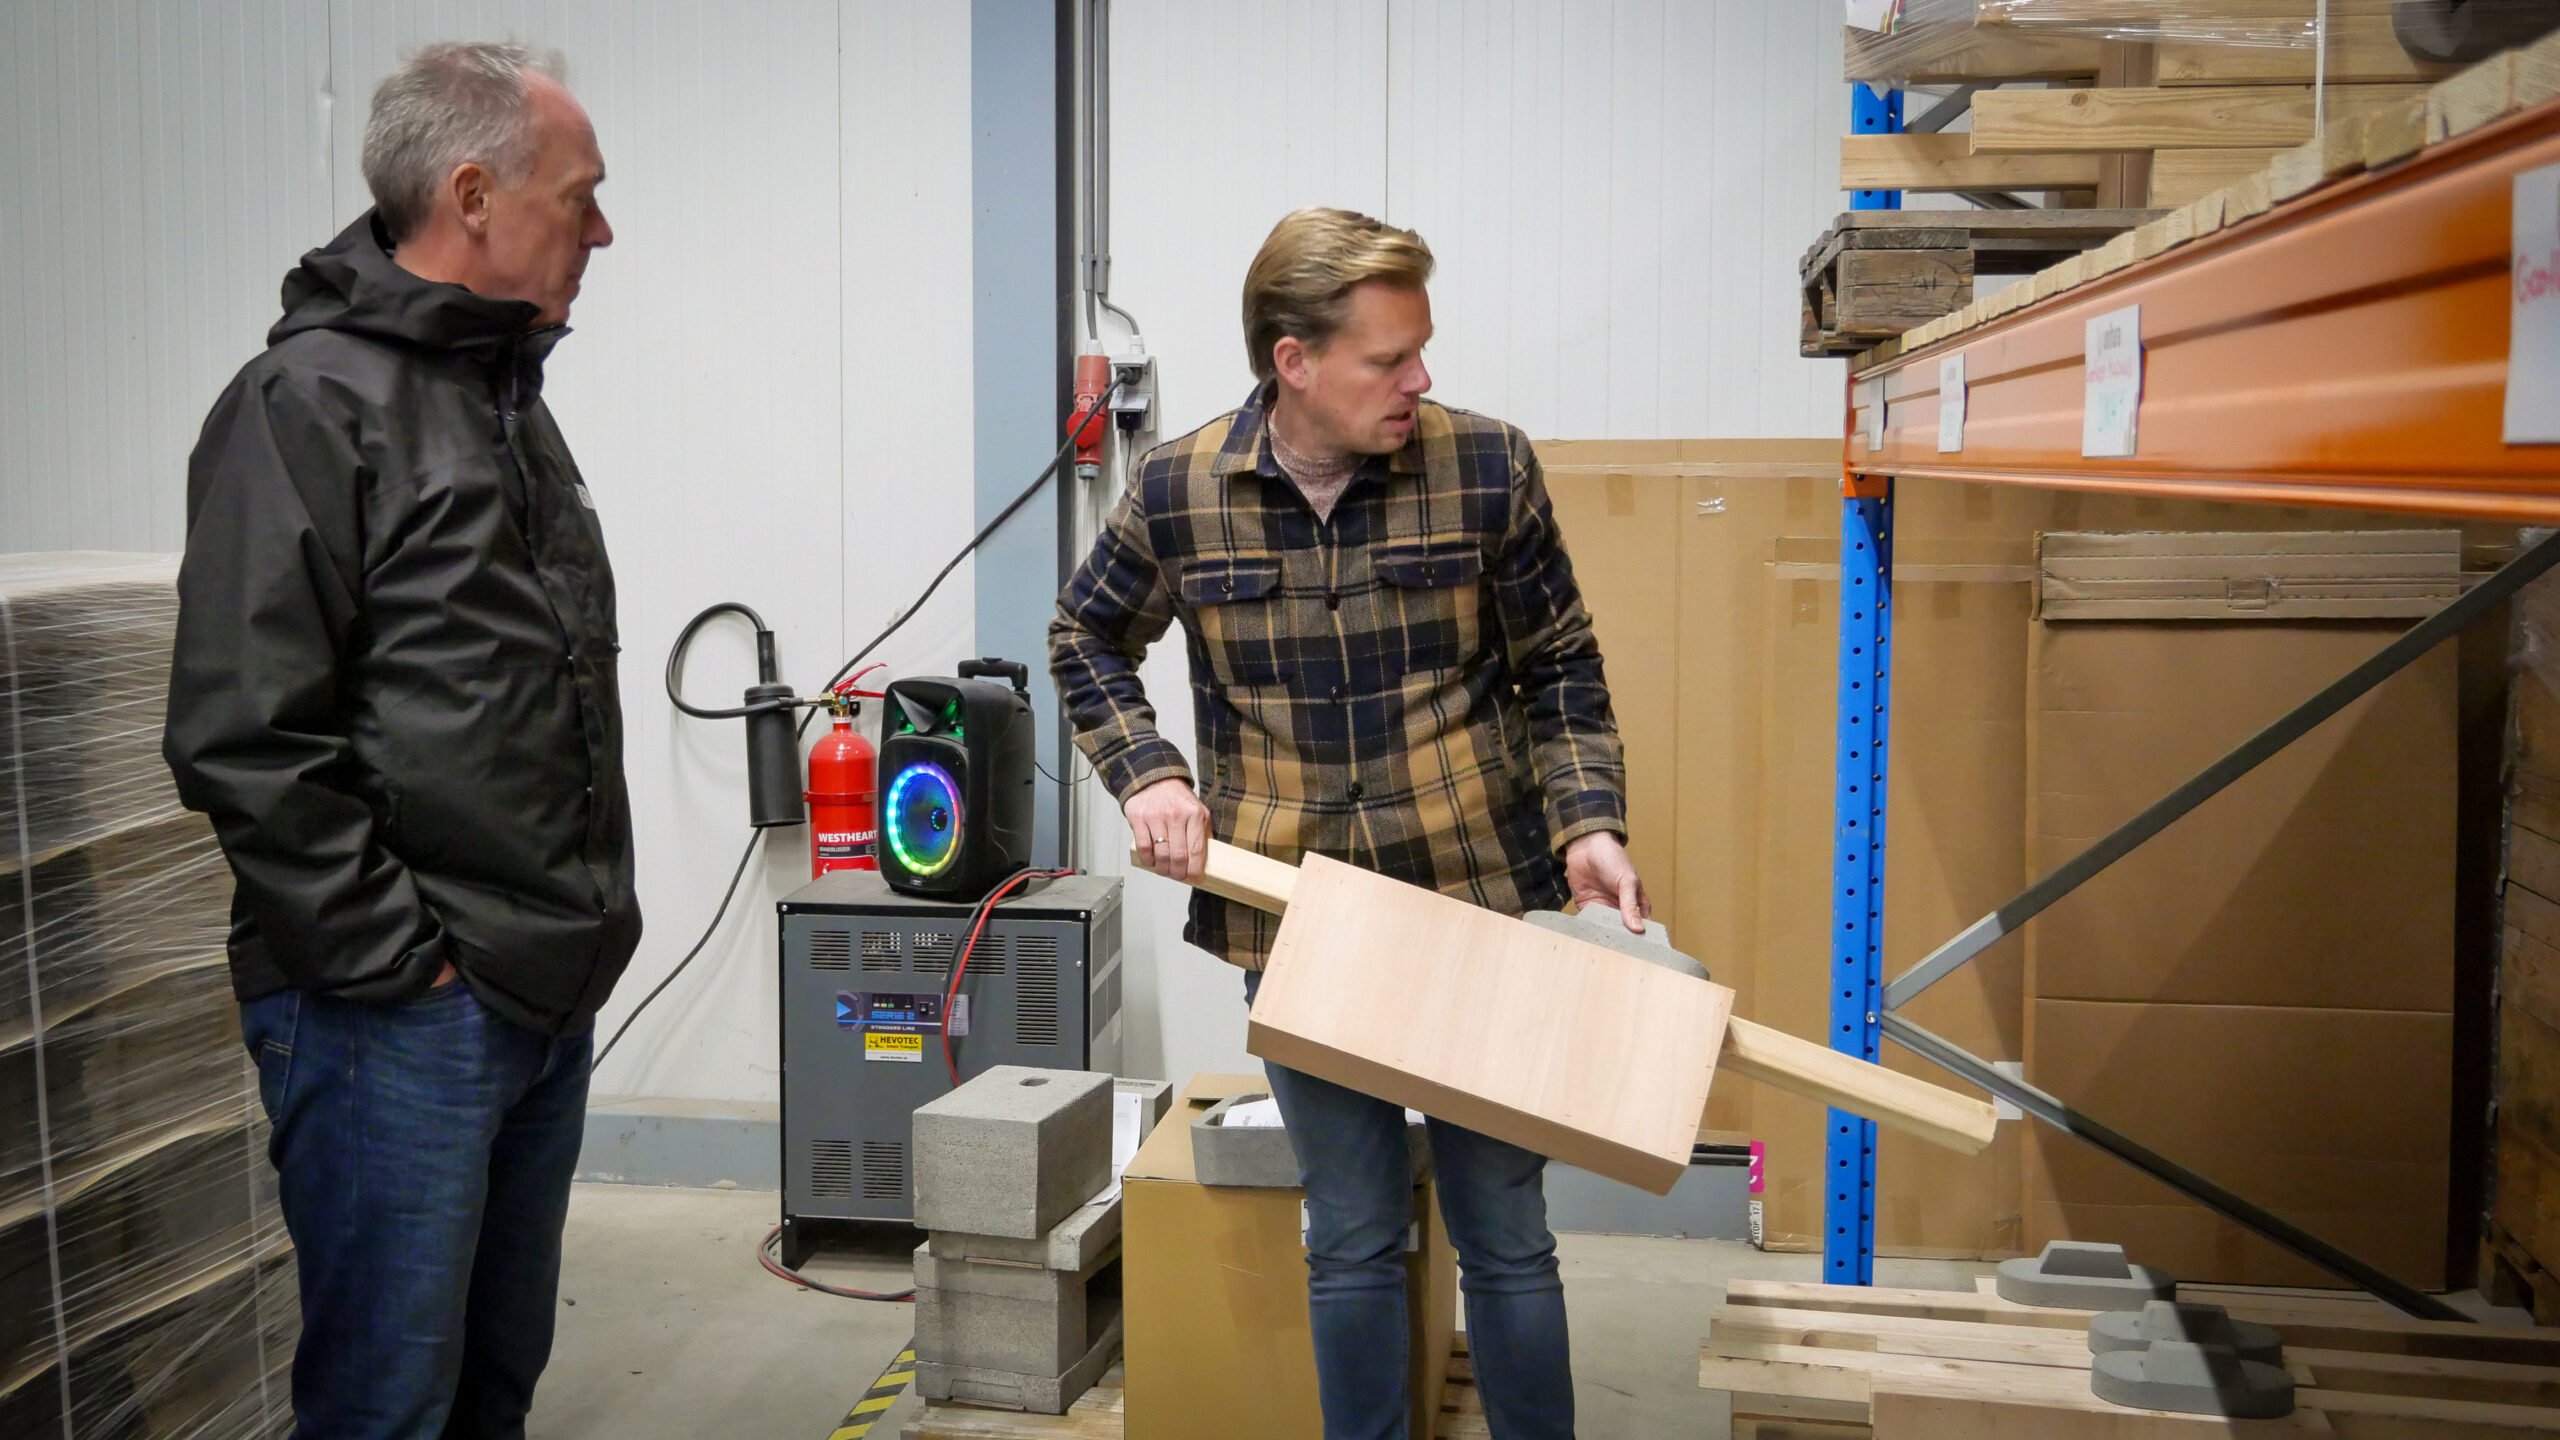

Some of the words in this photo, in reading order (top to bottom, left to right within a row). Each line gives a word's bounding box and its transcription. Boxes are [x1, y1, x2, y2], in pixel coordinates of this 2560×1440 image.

[818, 830, 878, 842] WESTHEART
[906, 1011, 916, 1020] 2
[880, 1036, 919, 1045] HEVOTEC
